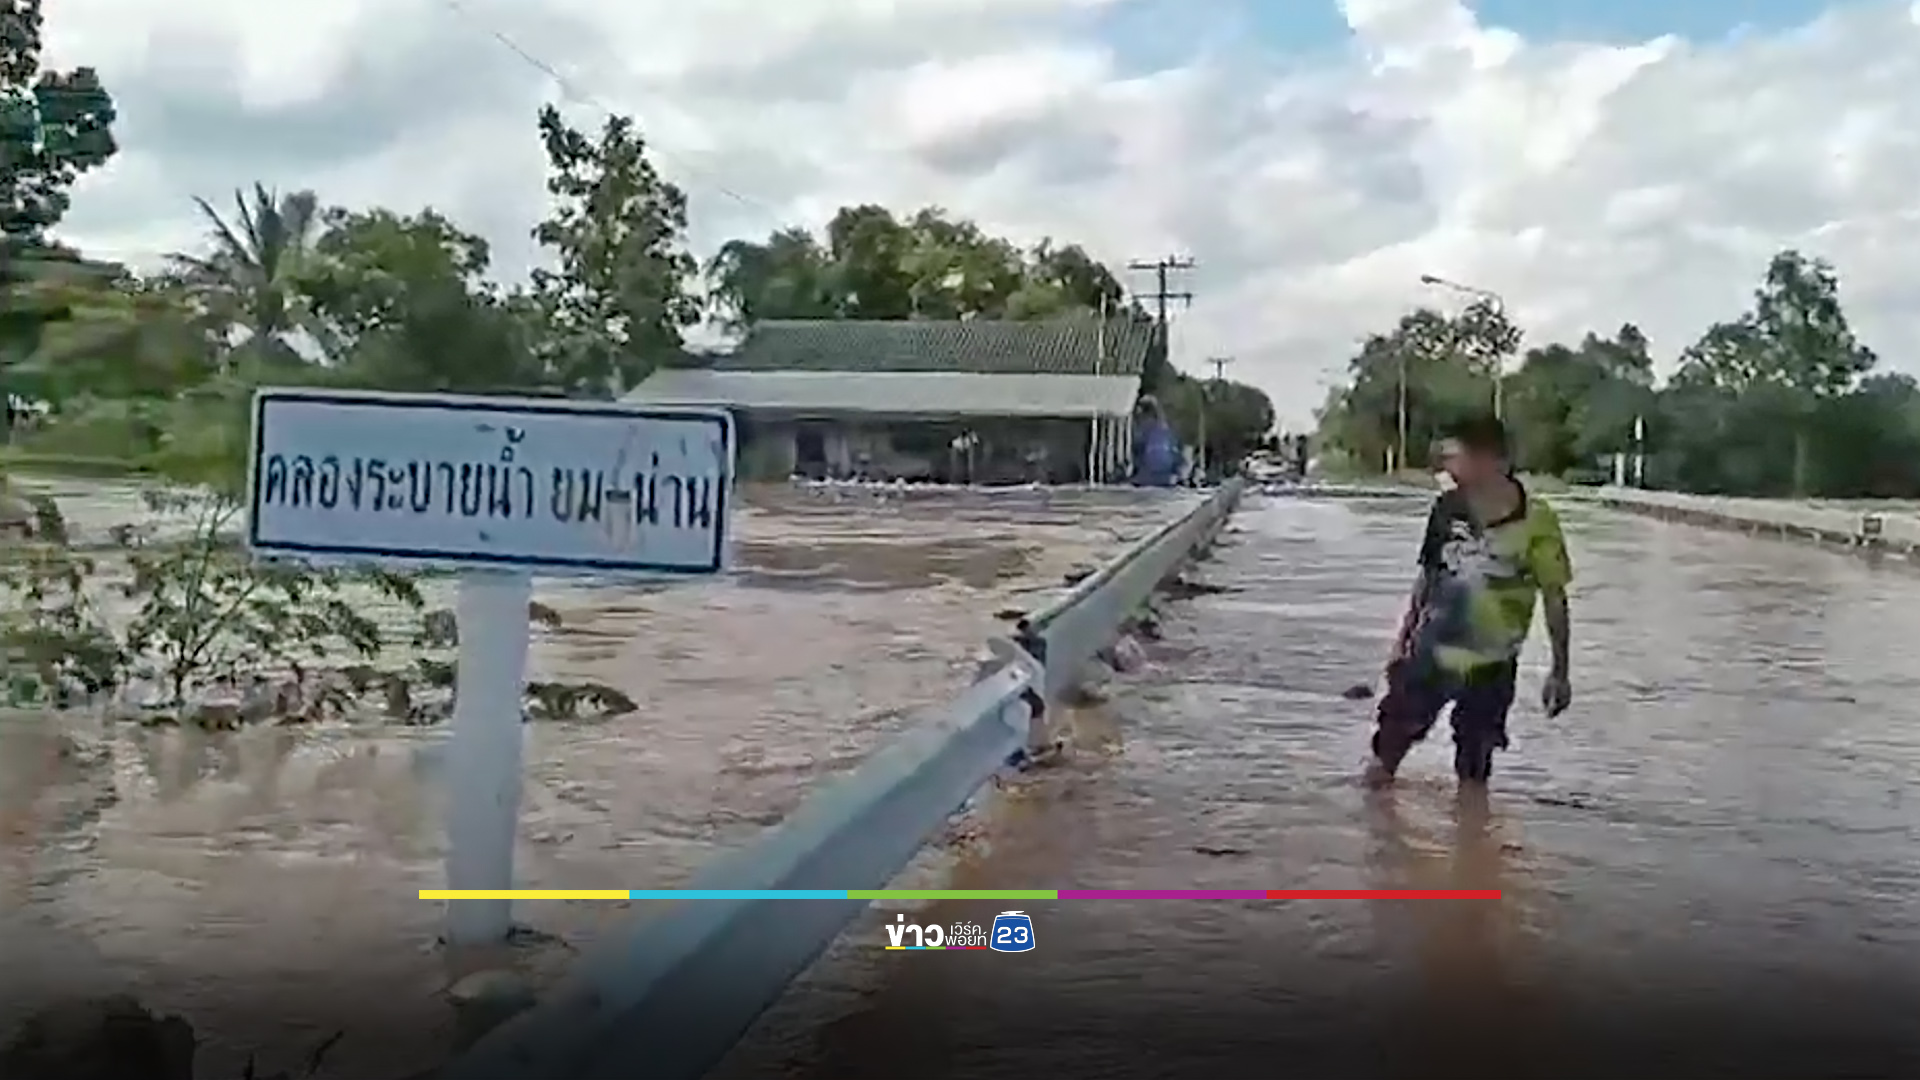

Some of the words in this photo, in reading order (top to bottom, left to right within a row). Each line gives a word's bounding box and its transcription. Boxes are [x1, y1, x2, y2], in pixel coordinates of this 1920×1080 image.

[265, 426, 533, 520] คลองระบายน้ำ
[552, 451, 711, 528] ยม-น่าน
